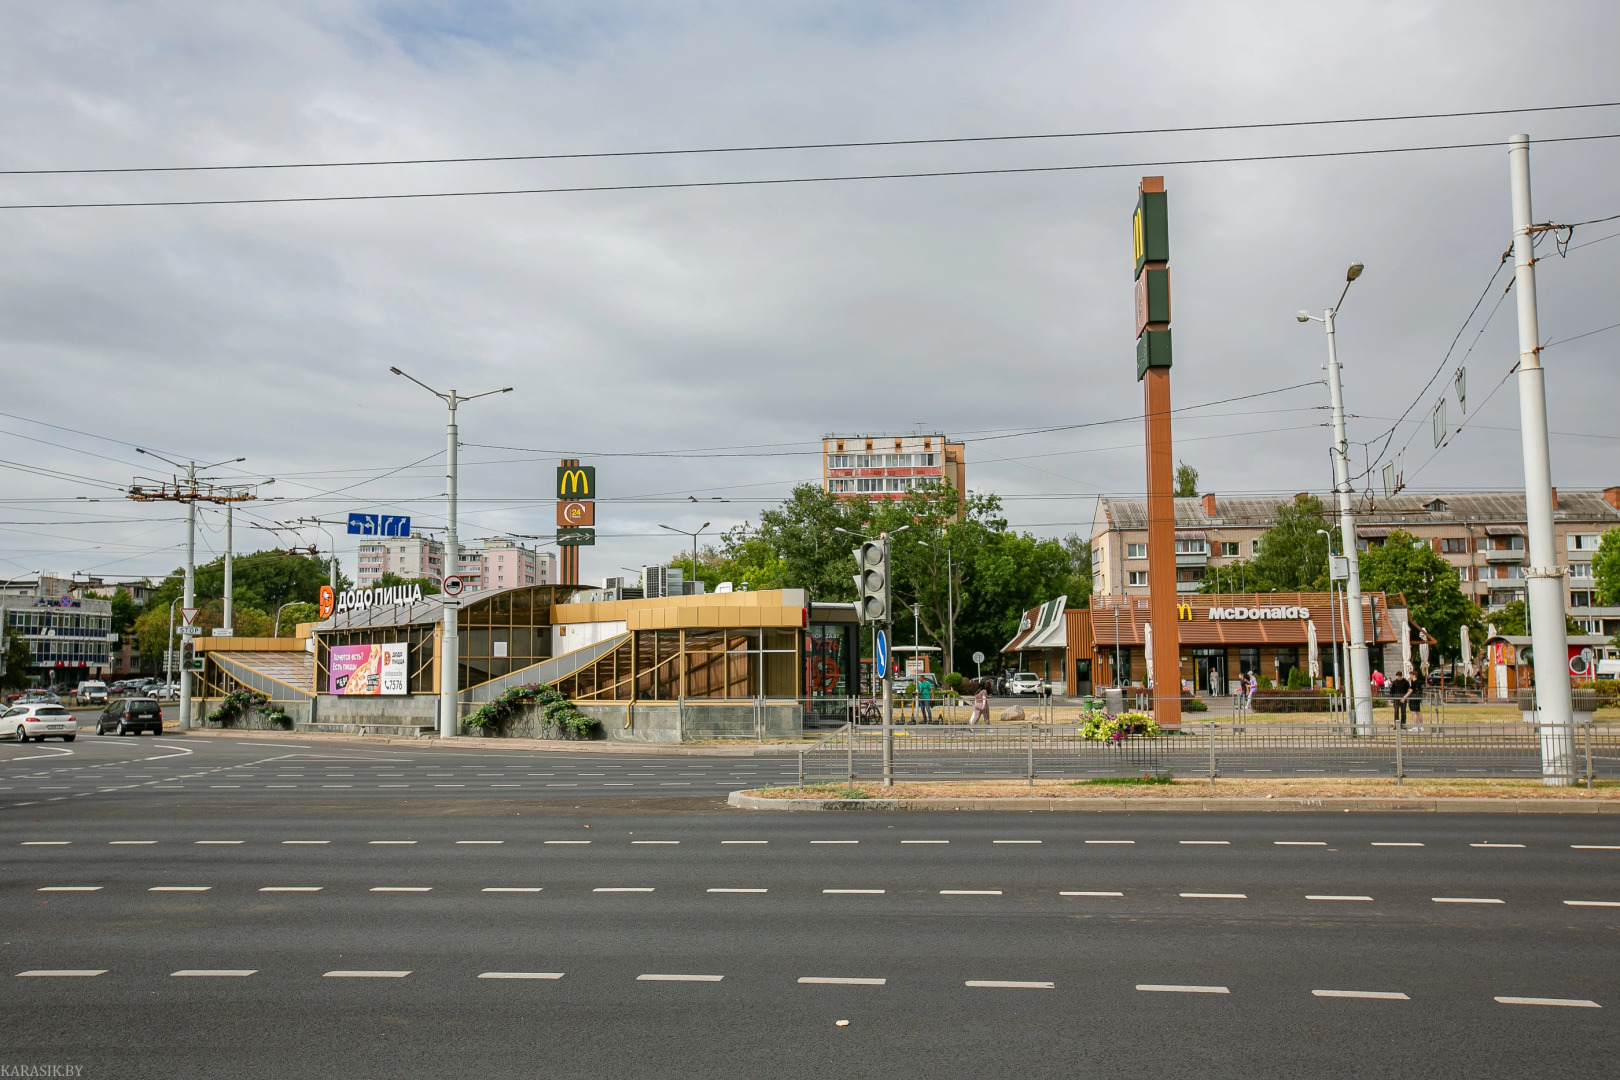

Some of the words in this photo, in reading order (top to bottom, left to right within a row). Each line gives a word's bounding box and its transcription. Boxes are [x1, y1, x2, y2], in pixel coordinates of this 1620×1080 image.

[561, 470, 588, 494] M
[337, 589, 373, 613] ДОДО
[374, 584, 422, 607] ПИЦЦА
[1208, 606, 1310, 620] McDonald's
[815, 639, 839, 651] 776
[332, 653, 351, 661] Хочется
[351, 652, 364, 661] есть?
[332, 663, 342, 671] Есть
[343, 663, 357, 671] пиццы
[389, 680, 403, 690] 7576
